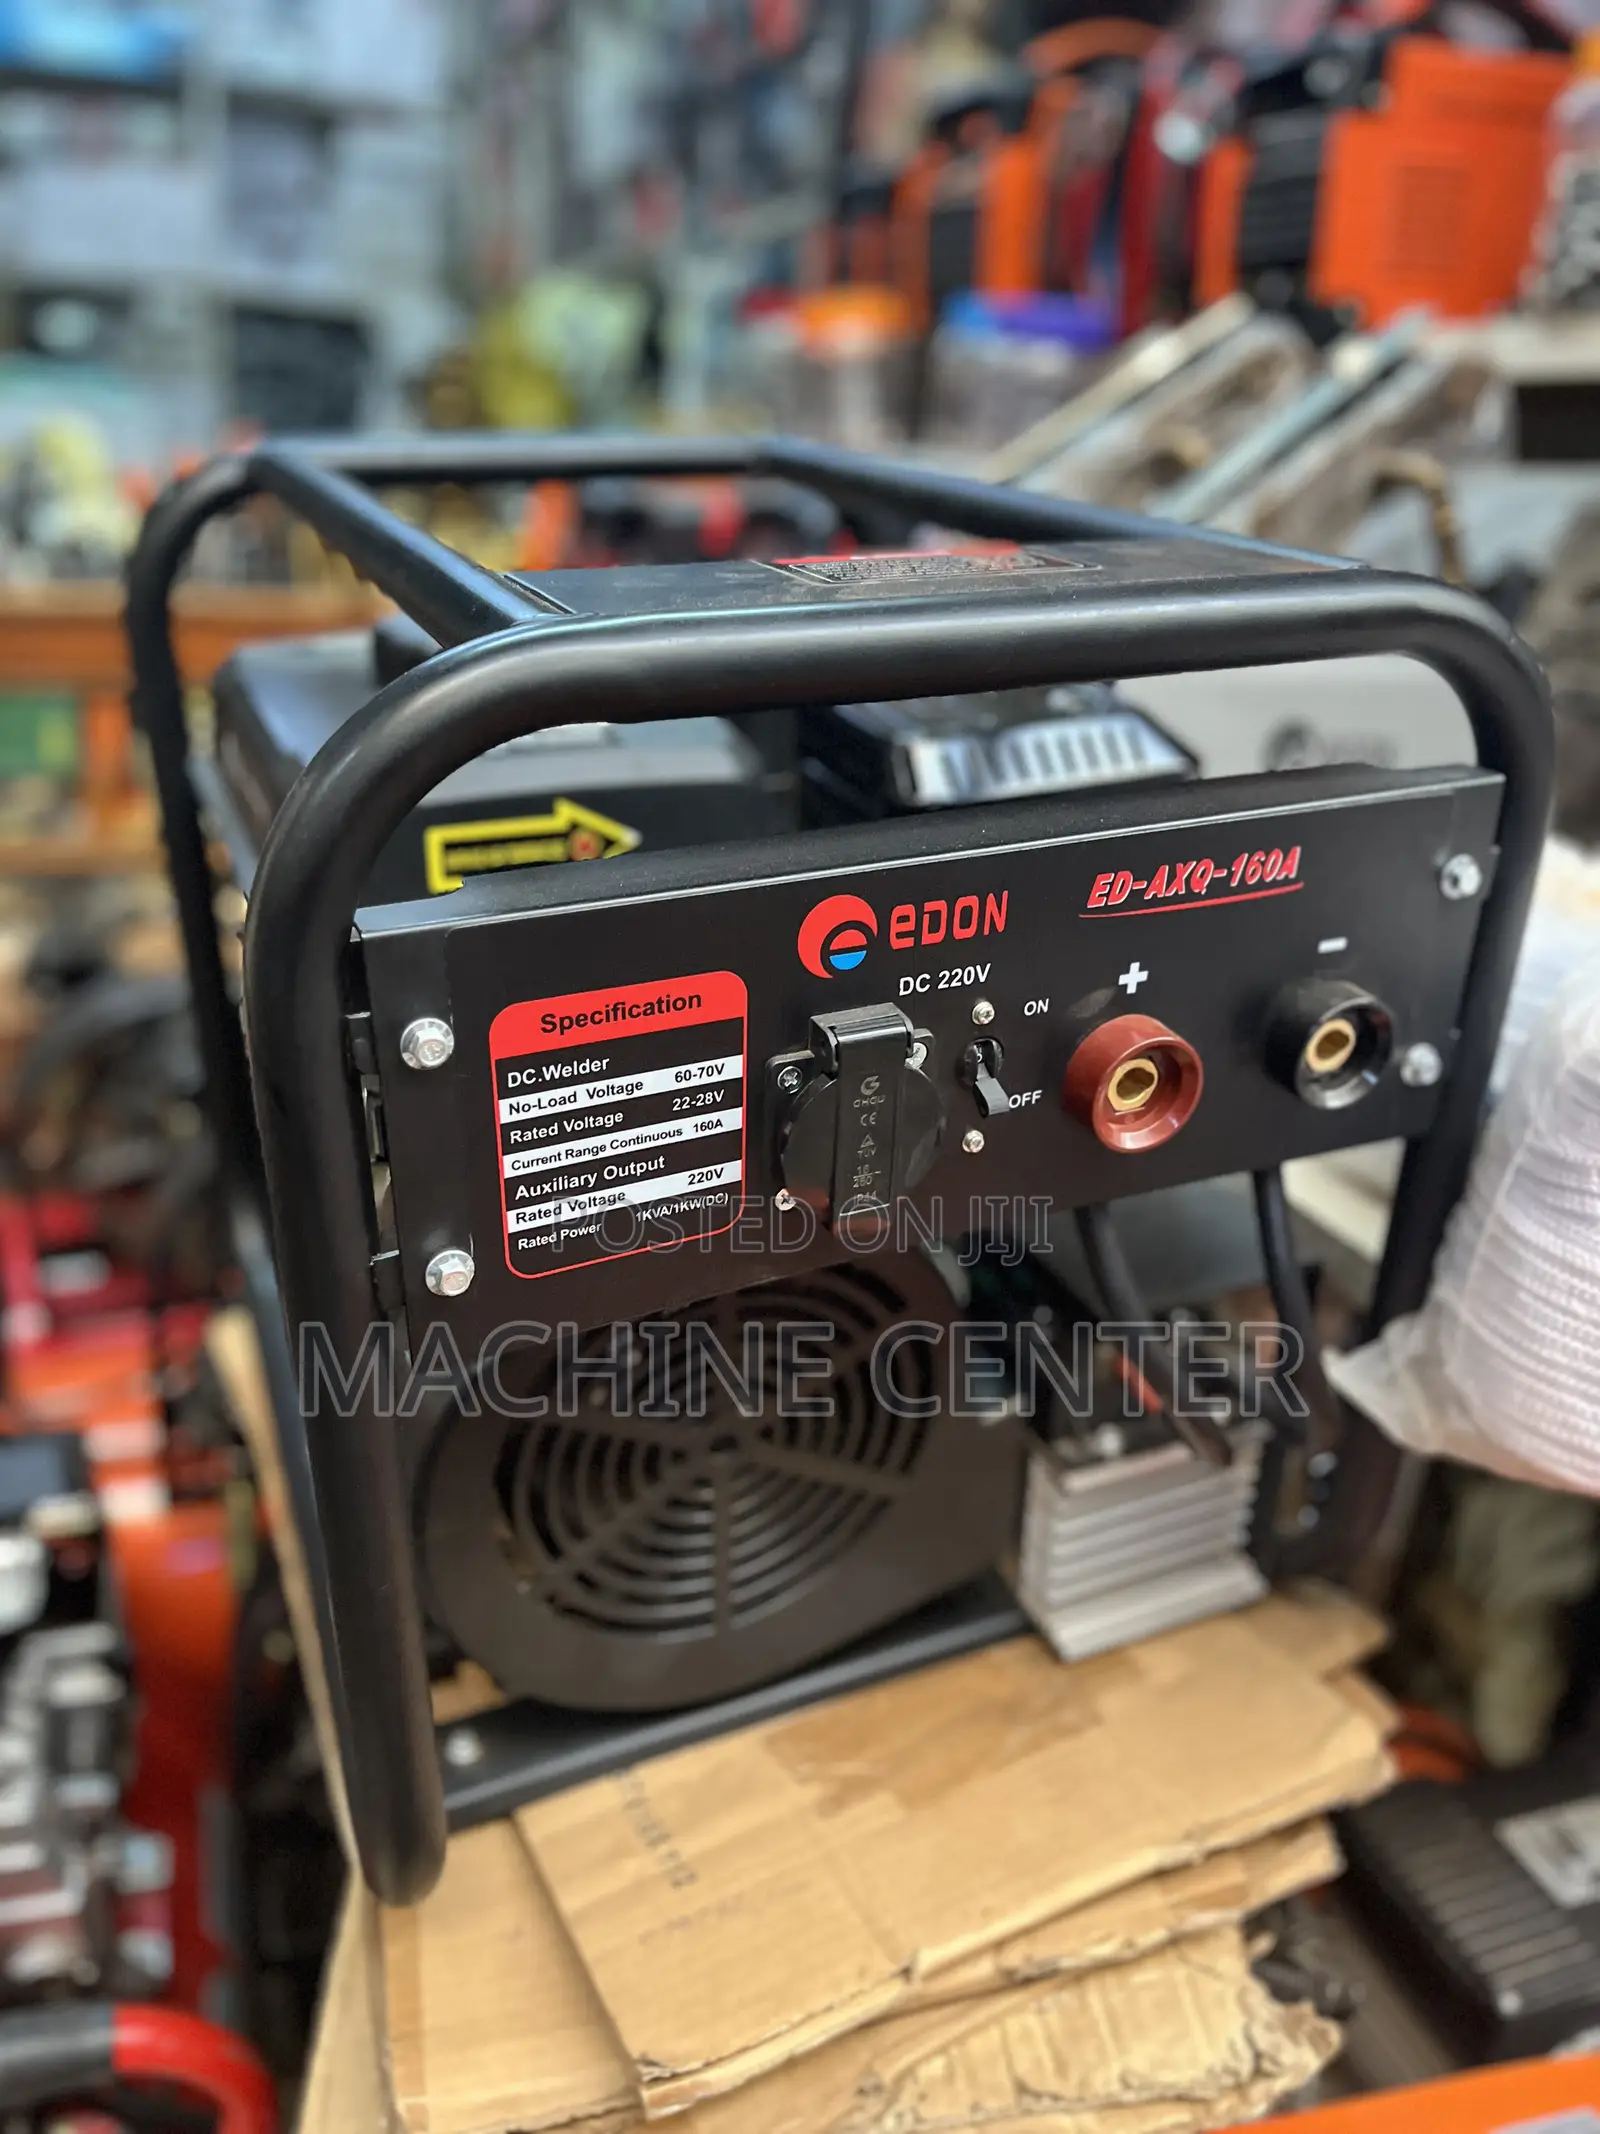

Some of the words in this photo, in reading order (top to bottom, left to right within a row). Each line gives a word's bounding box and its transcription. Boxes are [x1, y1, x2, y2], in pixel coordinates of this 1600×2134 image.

[1086, 846, 1302, 909] ED-AXQ-160A
[899, 973, 931, 996] DC
[938, 963, 991, 990] 220V
[540, 994, 702, 1035] Specification
[1024, 998, 1050, 1016] ON
[507, 1058, 610, 1088] DC.Welder
[509, 1091, 577, 1115] No-Load
[586, 1079, 644, 1102] Voltage
[675, 1063, 725, 1083] 60-70V
[510, 1122, 559, 1144] Rated
[563, 1112, 624, 1133] Voltage
[672, 1089, 725, 1111] 22-28V
[1008, 1089, 1042, 1109] OFF
[511, 1152, 562, 1171] Current
[565, 1143, 607, 1160] Range
[610, 1127, 683, 1150] Continuous
[693, 1118, 724, 1133] 160A
[515, 1173, 598, 1200] Auxiliary
[604, 1156, 665, 1181] Output
[516, 1201, 562, 1224] Rated
[567, 1191, 626, 1213] Voltage
[687, 1168, 725, 1186] 220V
[518, 1231, 557, 1251] Rated
[560, 1222, 602, 1241] Power
